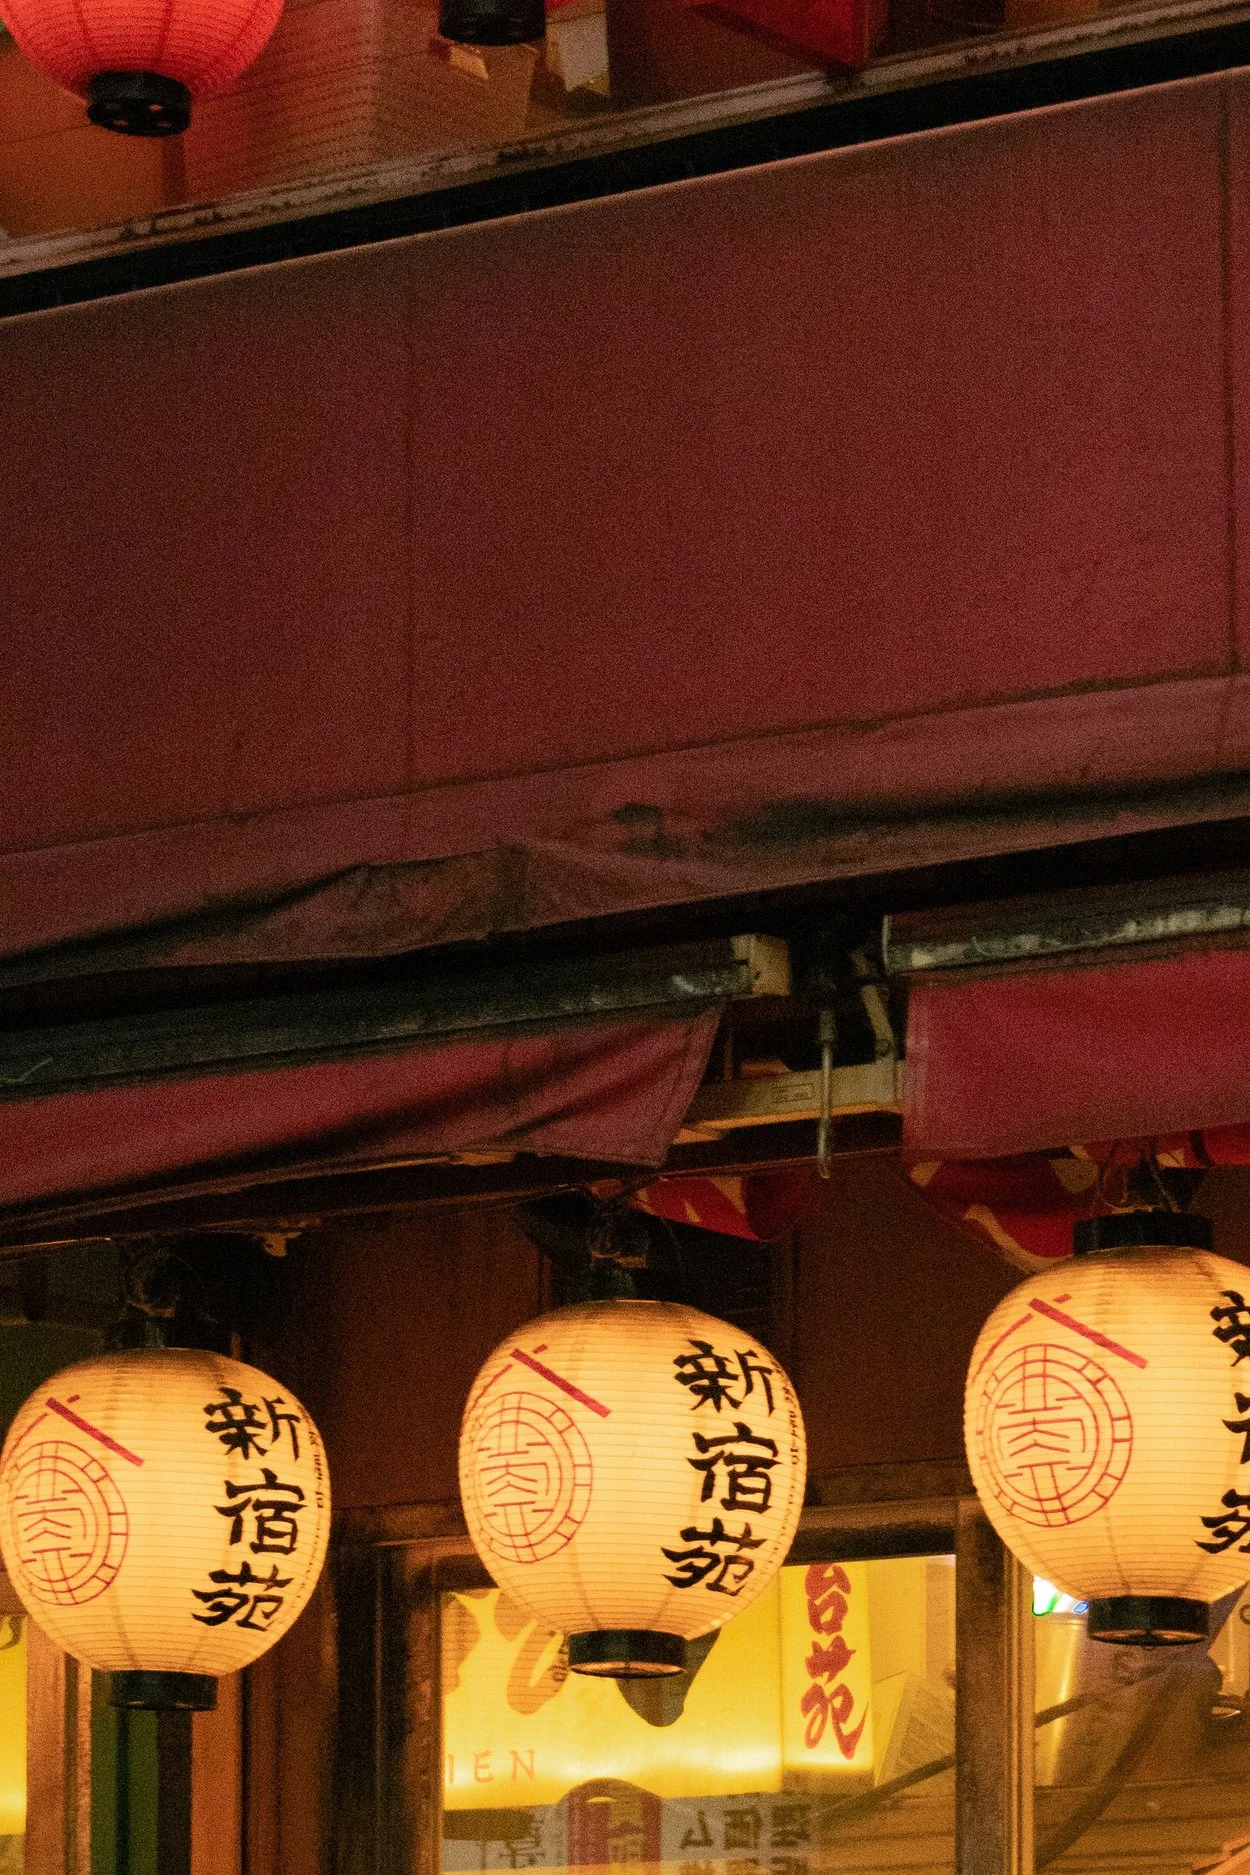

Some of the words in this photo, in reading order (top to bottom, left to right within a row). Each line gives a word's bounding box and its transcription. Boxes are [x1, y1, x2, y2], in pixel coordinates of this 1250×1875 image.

[191, 1386, 307, 1632] 新宿苑
[660, 1340, 781, 1597] 新宿苑
